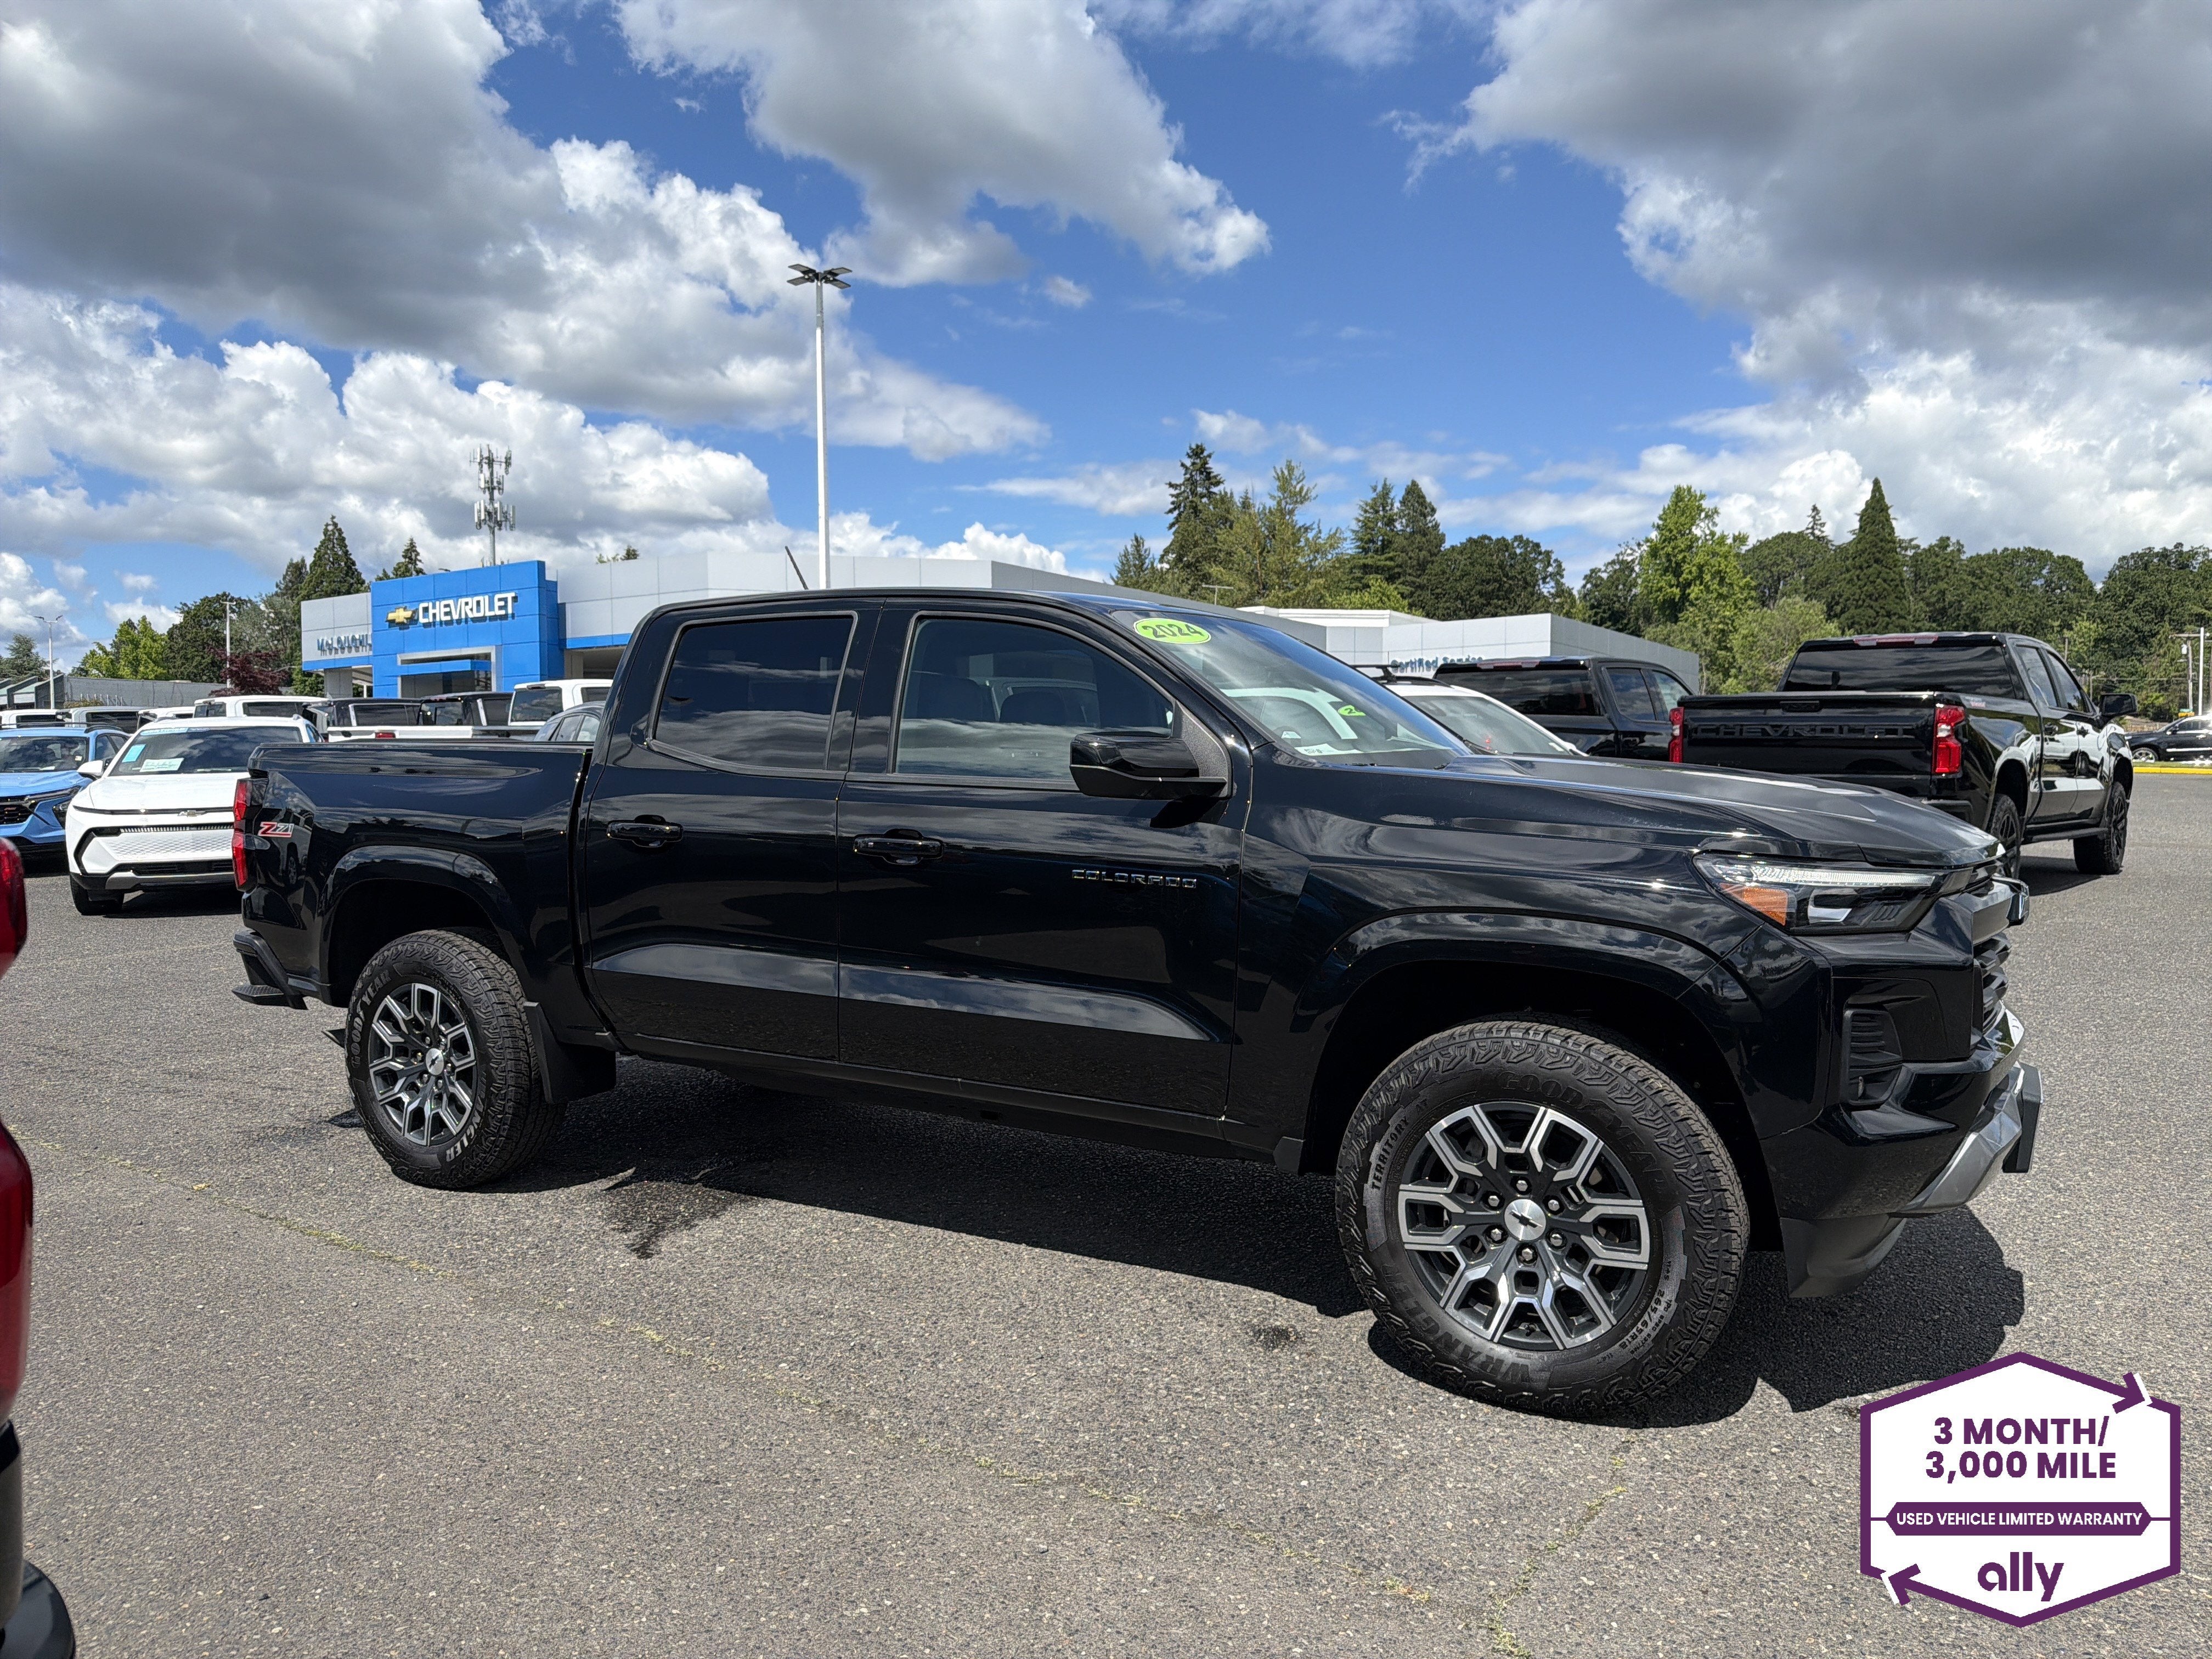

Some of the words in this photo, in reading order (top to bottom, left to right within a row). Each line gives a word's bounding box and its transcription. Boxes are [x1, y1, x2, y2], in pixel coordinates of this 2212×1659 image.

[419, 592, 516, 624] CHEVROLET
[1142, 624, 1205, 639] 2024
[1391, 656, 1438, 672] Certified
[1695, 724, 1915, 738] CHEVROLET
[257, 821, 295, 838] Z71
[1071, 870, 1197, 889] COLORADO
[351, 969, 392, 1069] GOODYEAR
[446, 1070, 487, 1163] WRANGLER
[1498, 1070, 1670, 1195] GOODYEAR
[1372, 1115, 1409, 1191] TERRITORY
[1381, 1263, 1531, 1384] WRANGLER
[1618, 1289, 1665, 1350] 265/65R18
